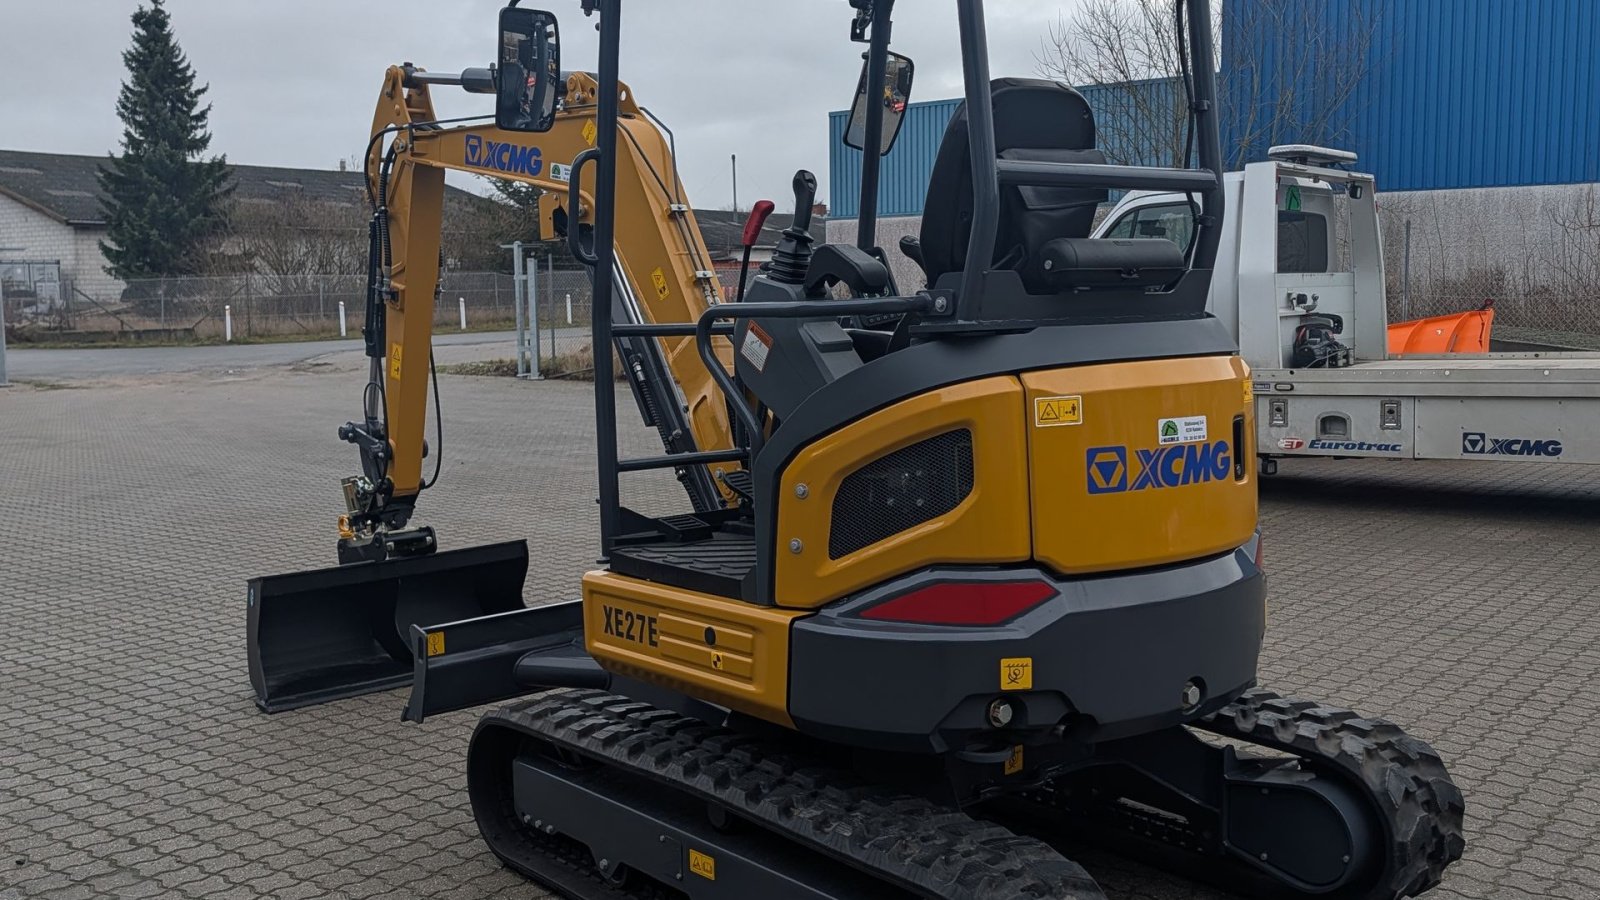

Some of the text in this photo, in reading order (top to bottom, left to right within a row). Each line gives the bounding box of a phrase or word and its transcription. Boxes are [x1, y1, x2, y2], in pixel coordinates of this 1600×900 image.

[482, 141, 543, 176] XCMG
[1308, 439, 1402, 452] Eurotrac
[1485, 438, 1563, 457] XCMG
[1128, 440, 1231, 491] XCMG
[603, 604, 659, 648] XE27E
